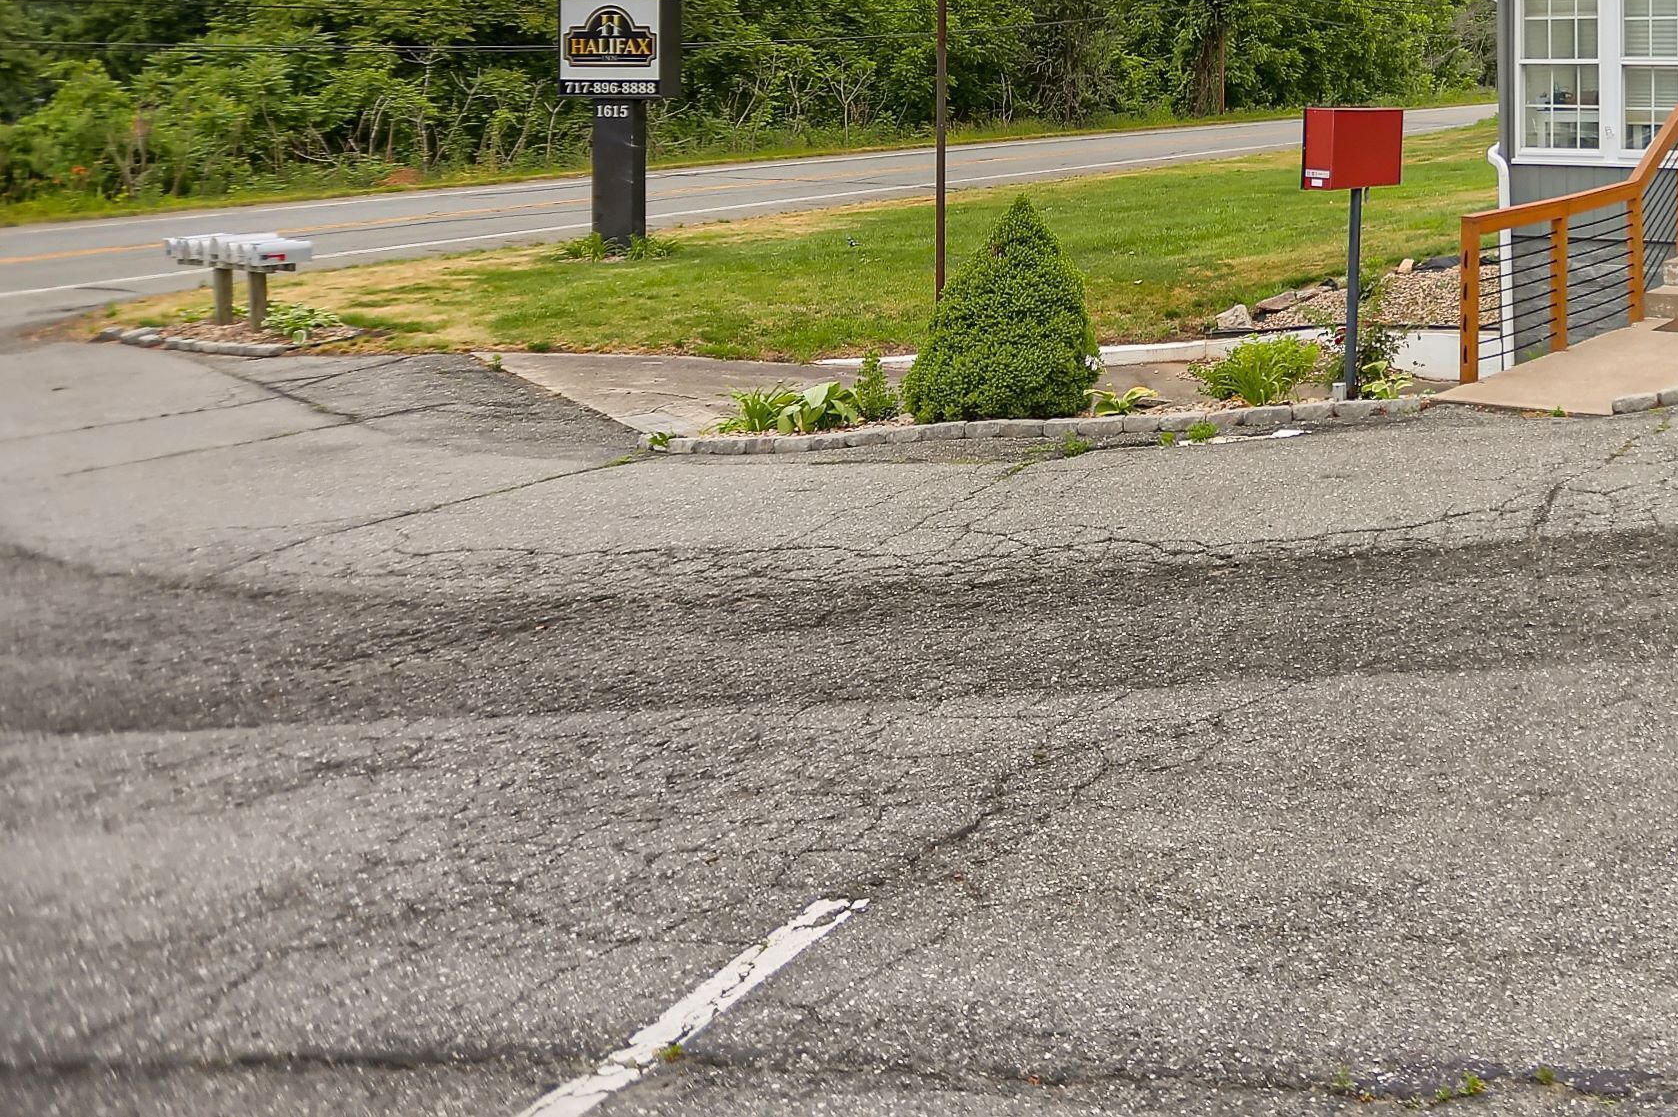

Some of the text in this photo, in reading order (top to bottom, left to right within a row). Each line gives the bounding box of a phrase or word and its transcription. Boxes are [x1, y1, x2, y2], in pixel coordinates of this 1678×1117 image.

[571, 38, 651, 54] HALIFAX
[564, 82, 656, 94] 717-896-8888
[597, 105, 629, 117] 1615
